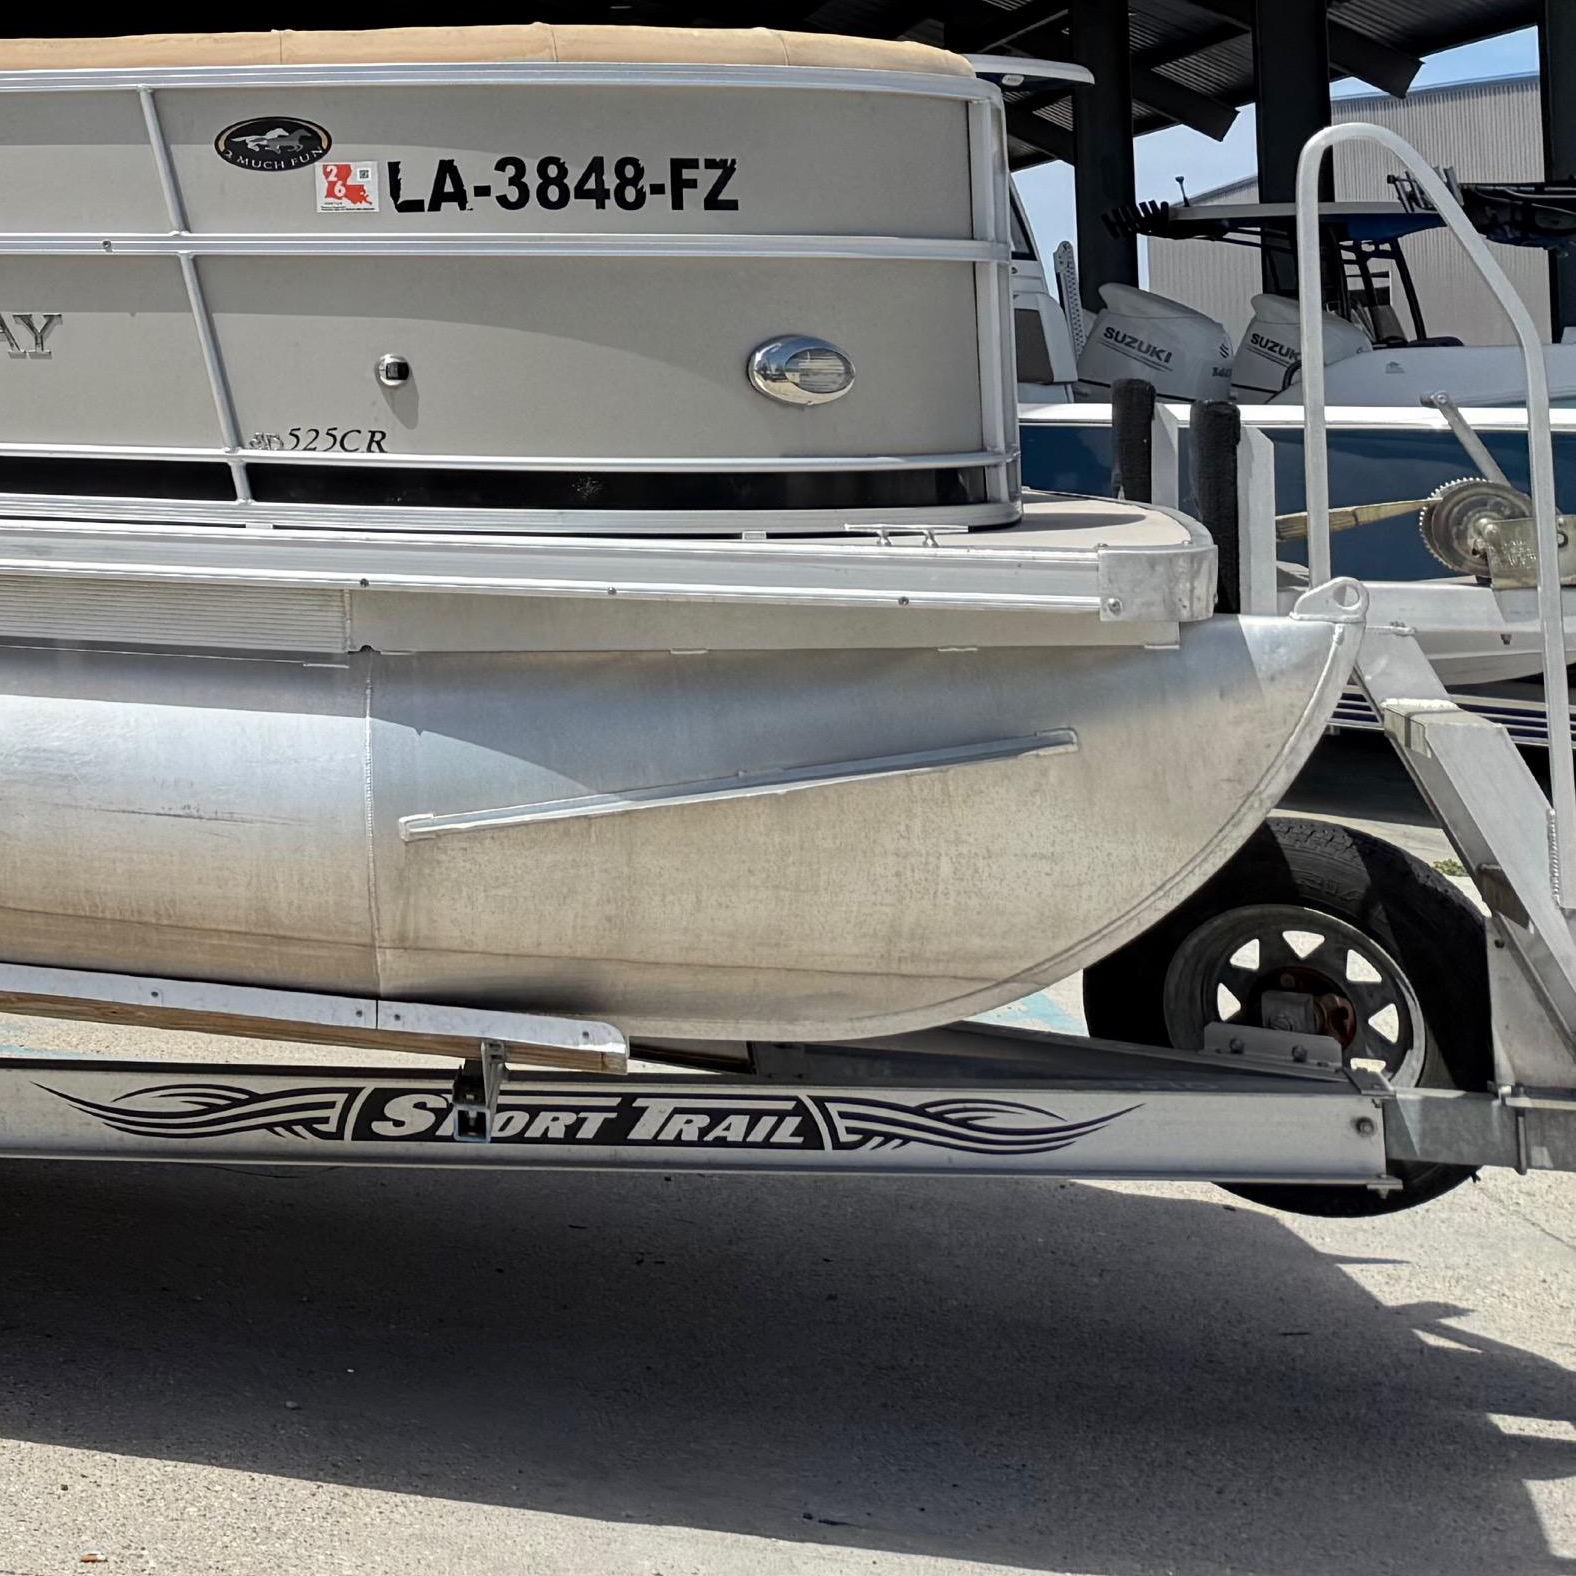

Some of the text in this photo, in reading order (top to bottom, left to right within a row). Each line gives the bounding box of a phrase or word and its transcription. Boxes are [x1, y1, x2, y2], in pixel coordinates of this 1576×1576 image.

[236, 155, 285, 169] MUCH
[290, 146, 323, 167] FUN
[387, 156, 739, 212] LA-3848-FZ
[1103, 326, 1173, 364] SUZUKI
[1250, 333, 1300, 360] SUZUK
[288, 427, 390, 454] 525CR
[371, 1092, 805, 1144] SORT TRAIL
